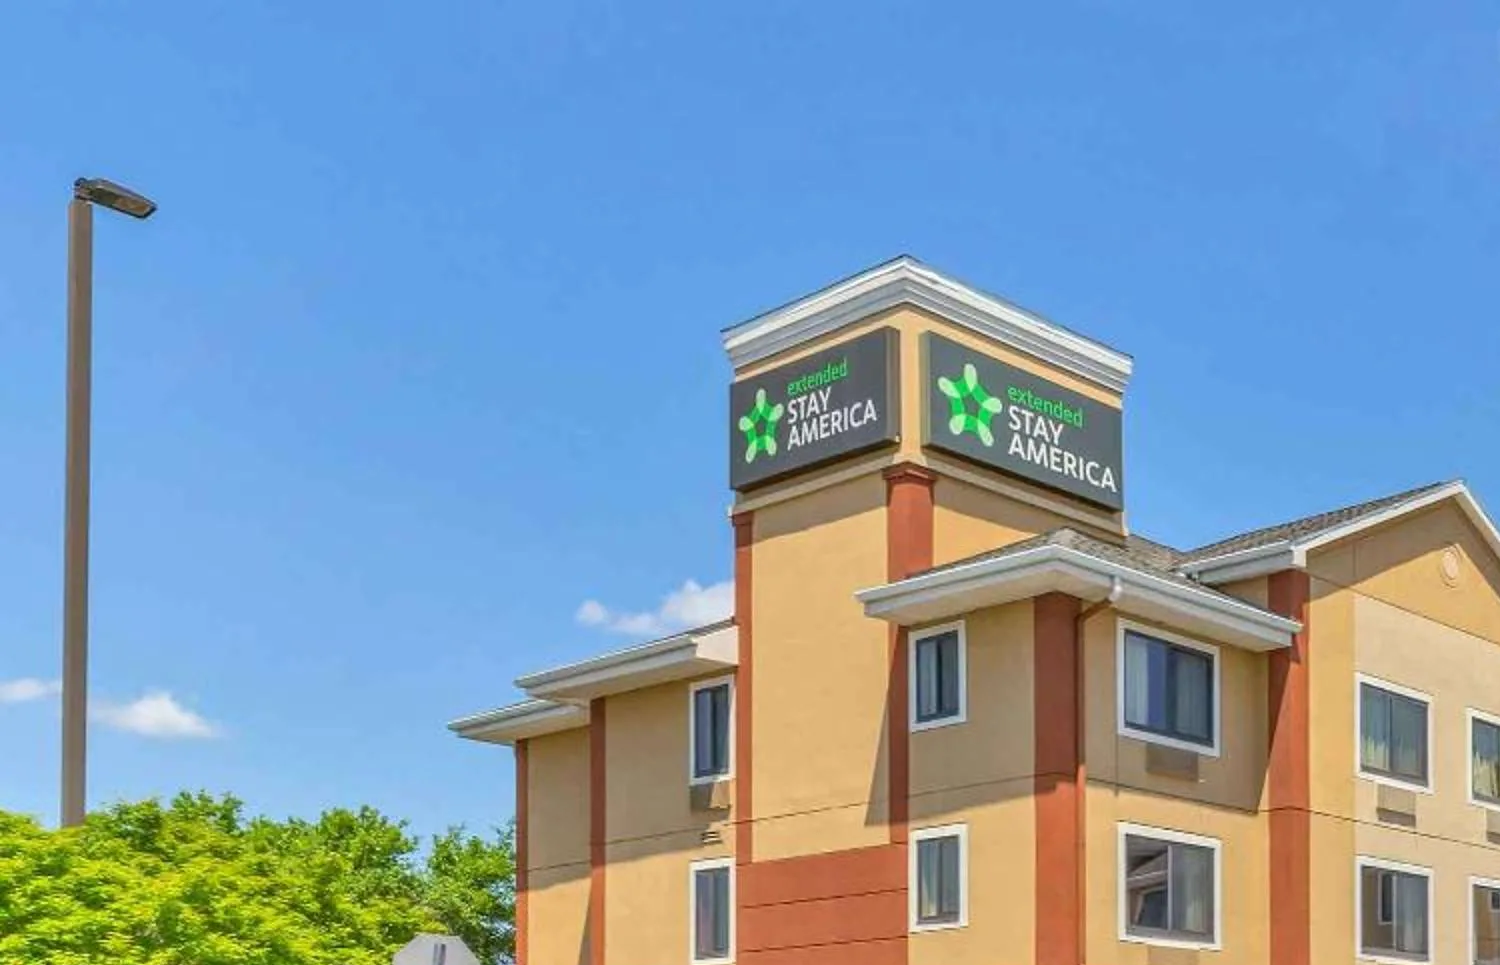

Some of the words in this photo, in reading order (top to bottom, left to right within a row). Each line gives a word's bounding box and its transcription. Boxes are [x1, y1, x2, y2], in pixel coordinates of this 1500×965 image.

[787, 358, 848, 397] extended
[786, 387, 832, 425] STAY
[787, 399, 878, 451] AMERICA
[1007, 385, 1084, 428] extended
[1007, 406, 1066, 444] STAY
[1007, 436, 1118, 493] AMERICA
